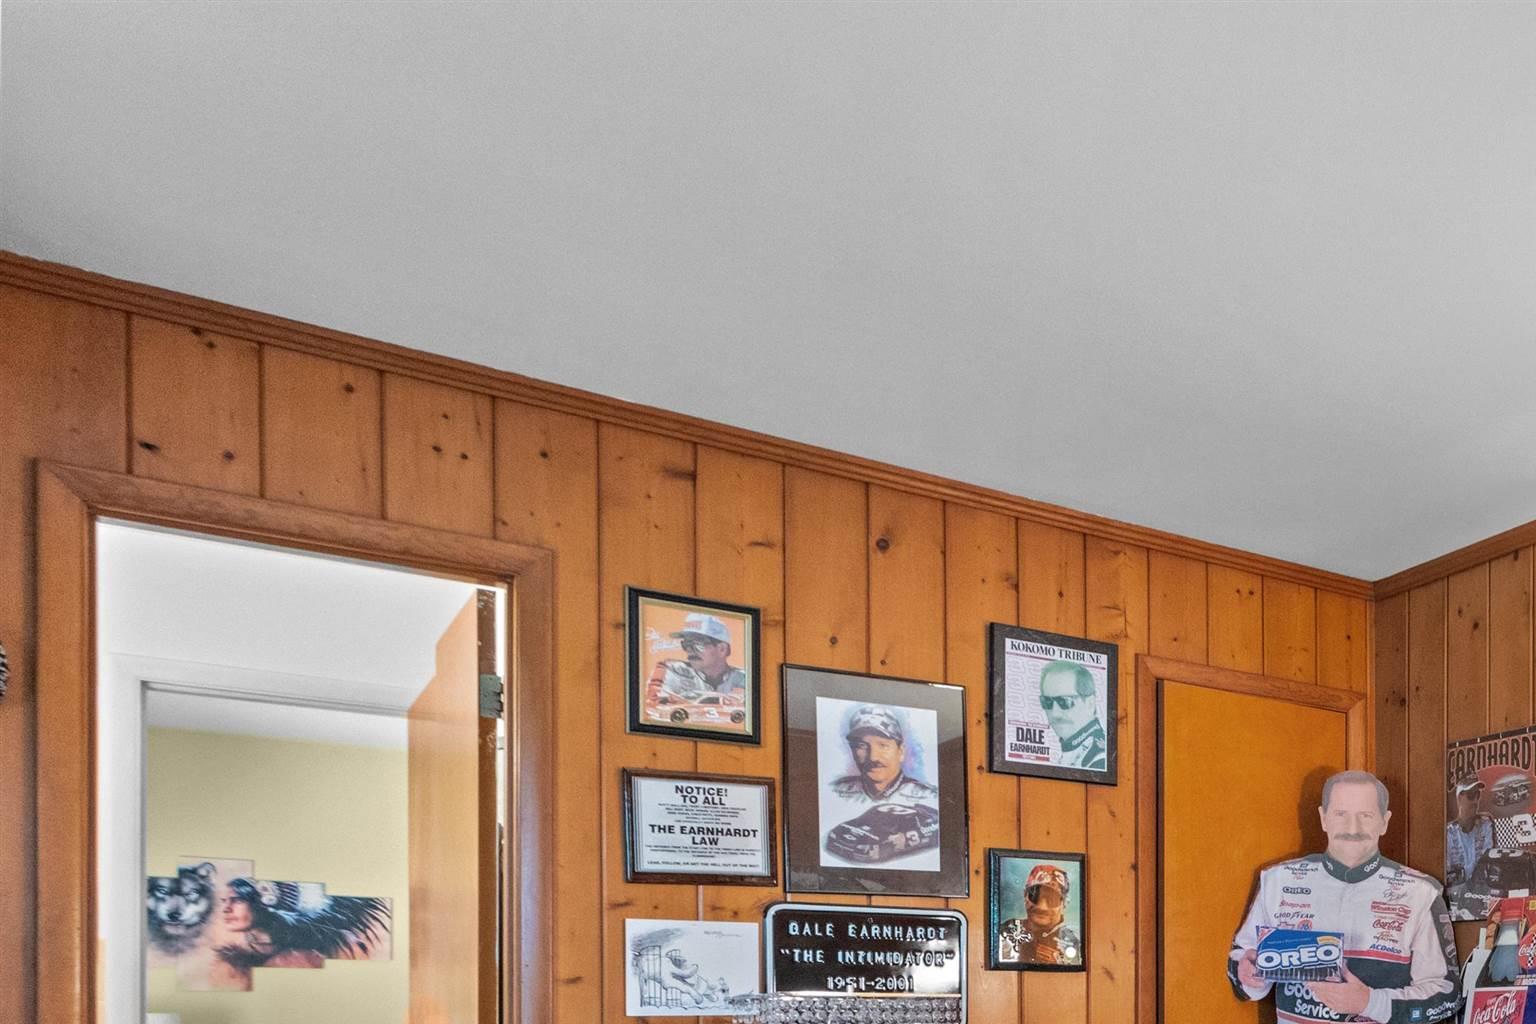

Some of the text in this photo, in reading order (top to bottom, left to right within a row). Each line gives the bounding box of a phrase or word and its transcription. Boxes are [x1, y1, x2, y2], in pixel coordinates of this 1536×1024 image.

[1011, 641, 1102, 664] KOKOMO TRIBUNE
[1016, 727, 1045, 745] DALE
[1010, 743, 1050, 755] EARNHARDT
[675, 785, 728, 797] NOTICE!
[680, 795, 726, 806] TO ALL
[649, 824, 758, 838] THE EARNHARDT
[692, 837, 719, 846] LAW
[1283, 887, 1311, 895] OREO
[788, 921, 948, 941] DALE EARNHARDT
[1257, 945, 1340, 968] OREO
[1295, 999, 1340, 1019] Service
